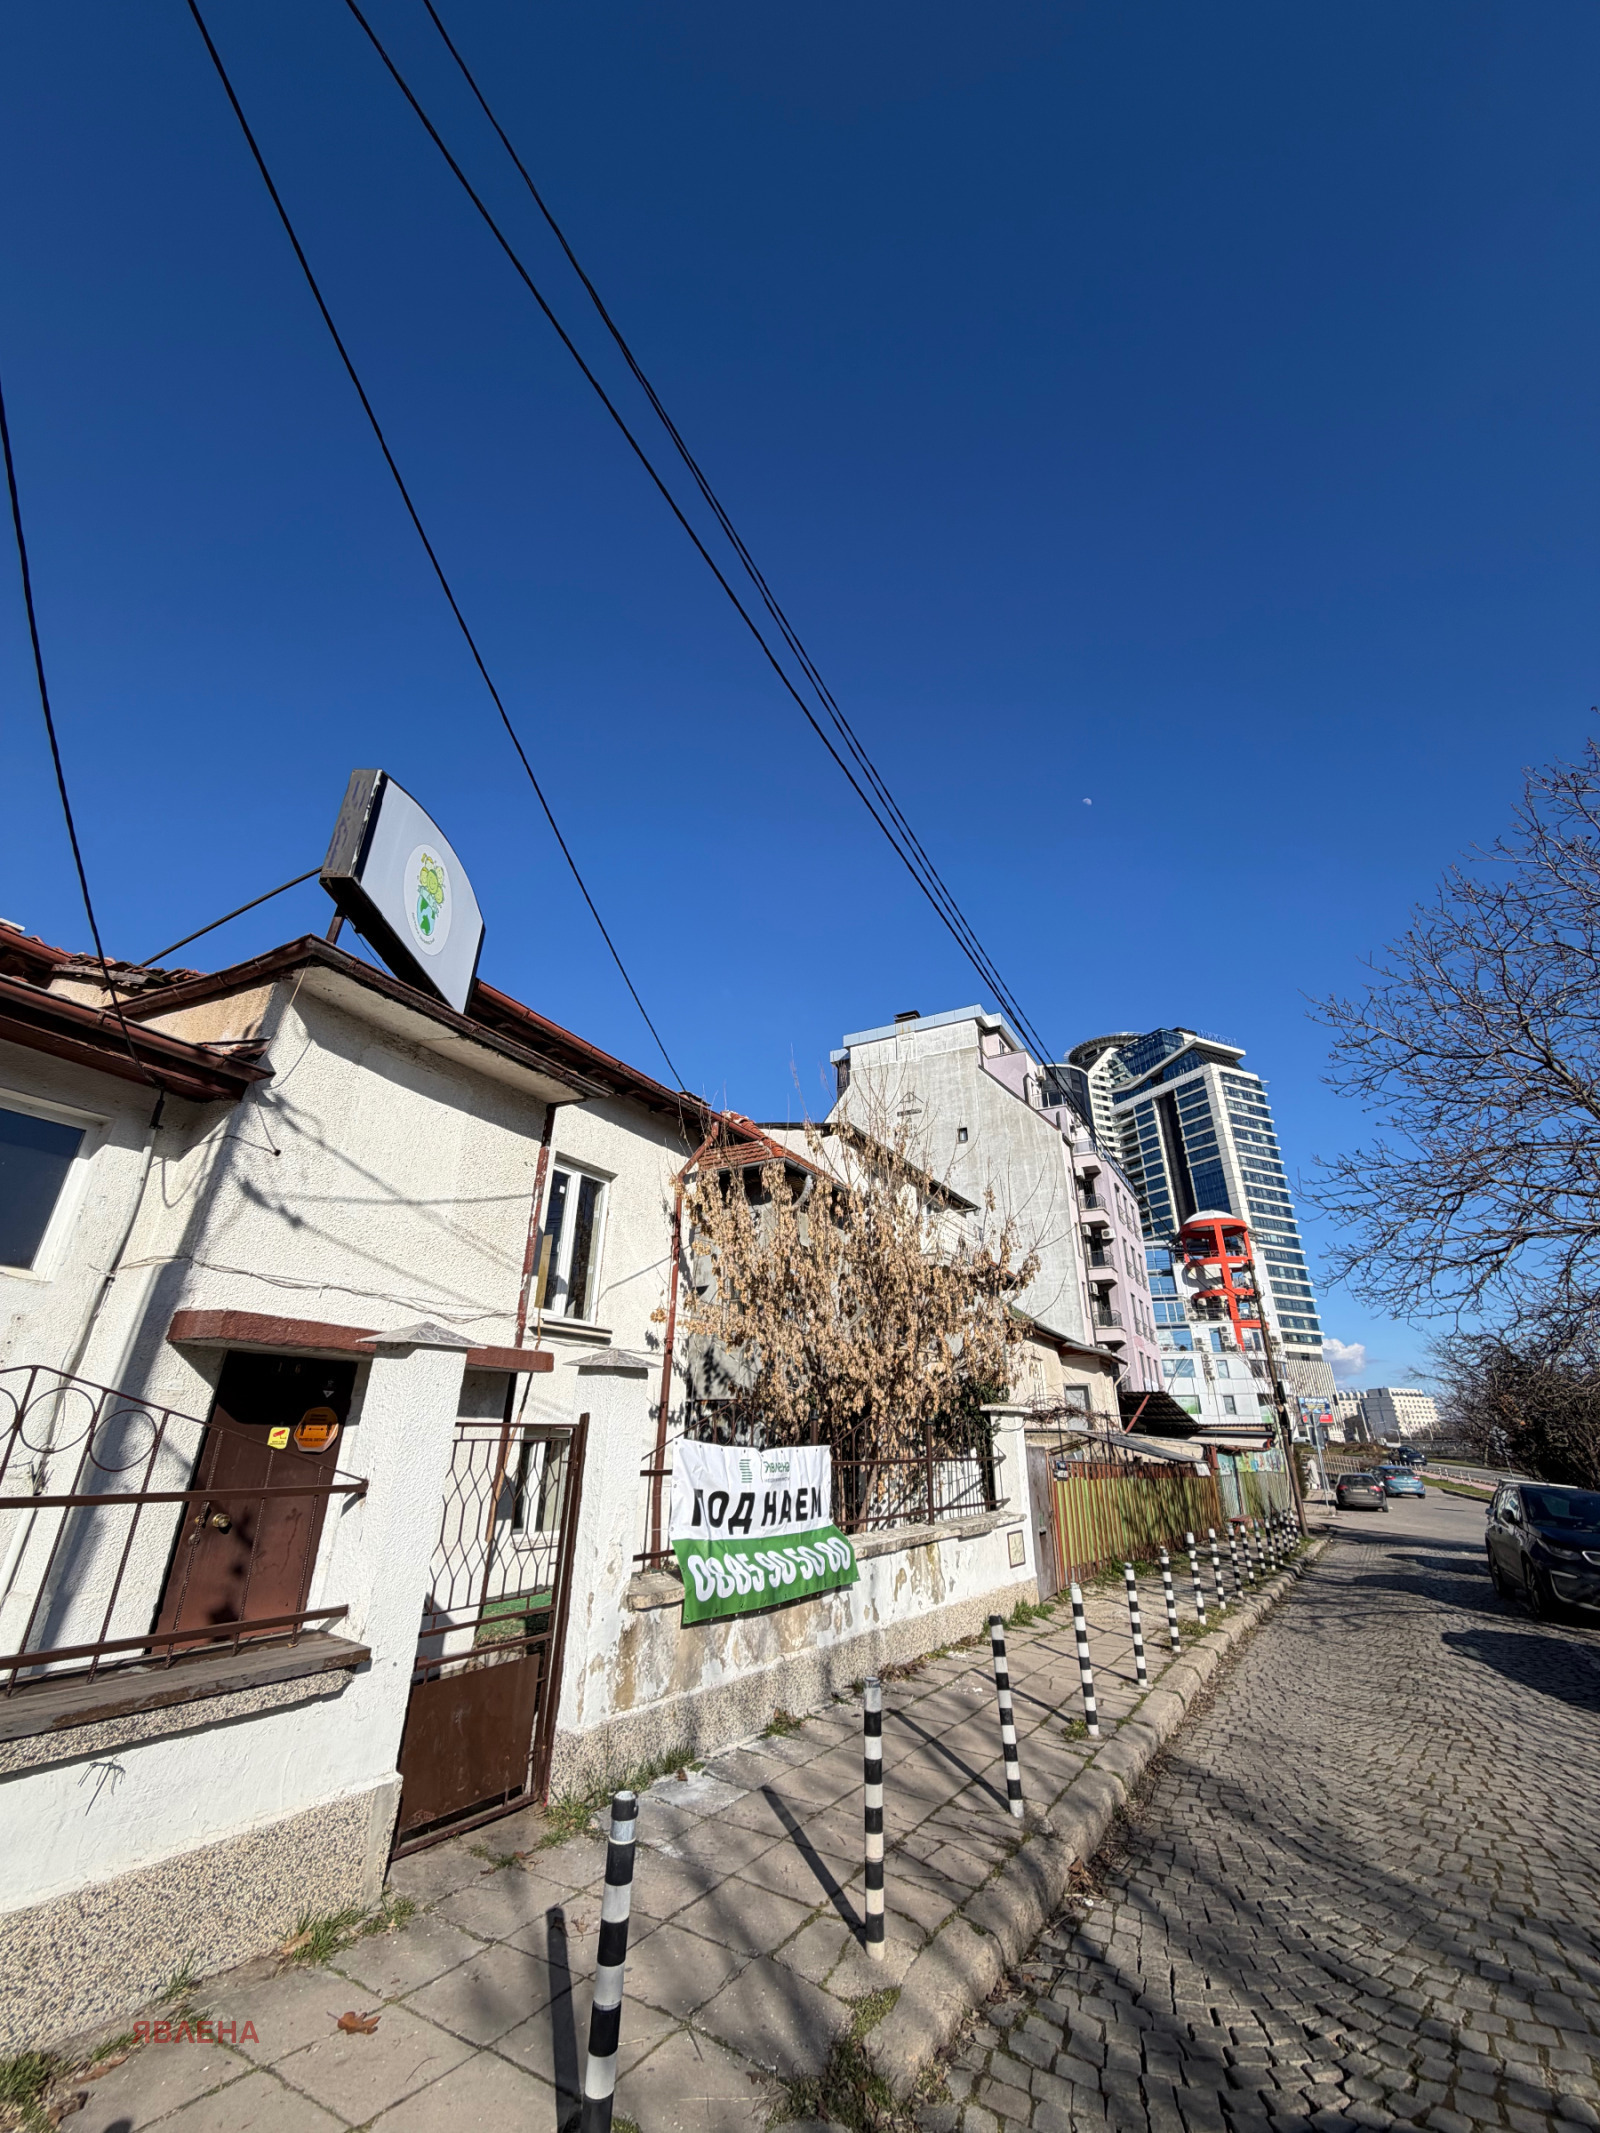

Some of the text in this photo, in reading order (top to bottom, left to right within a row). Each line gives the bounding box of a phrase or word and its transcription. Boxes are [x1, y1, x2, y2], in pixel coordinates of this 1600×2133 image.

[761, 1487, 822, 1526] НАЕМ
[687, 1536, 851, 1602] 0885 90 50 80
